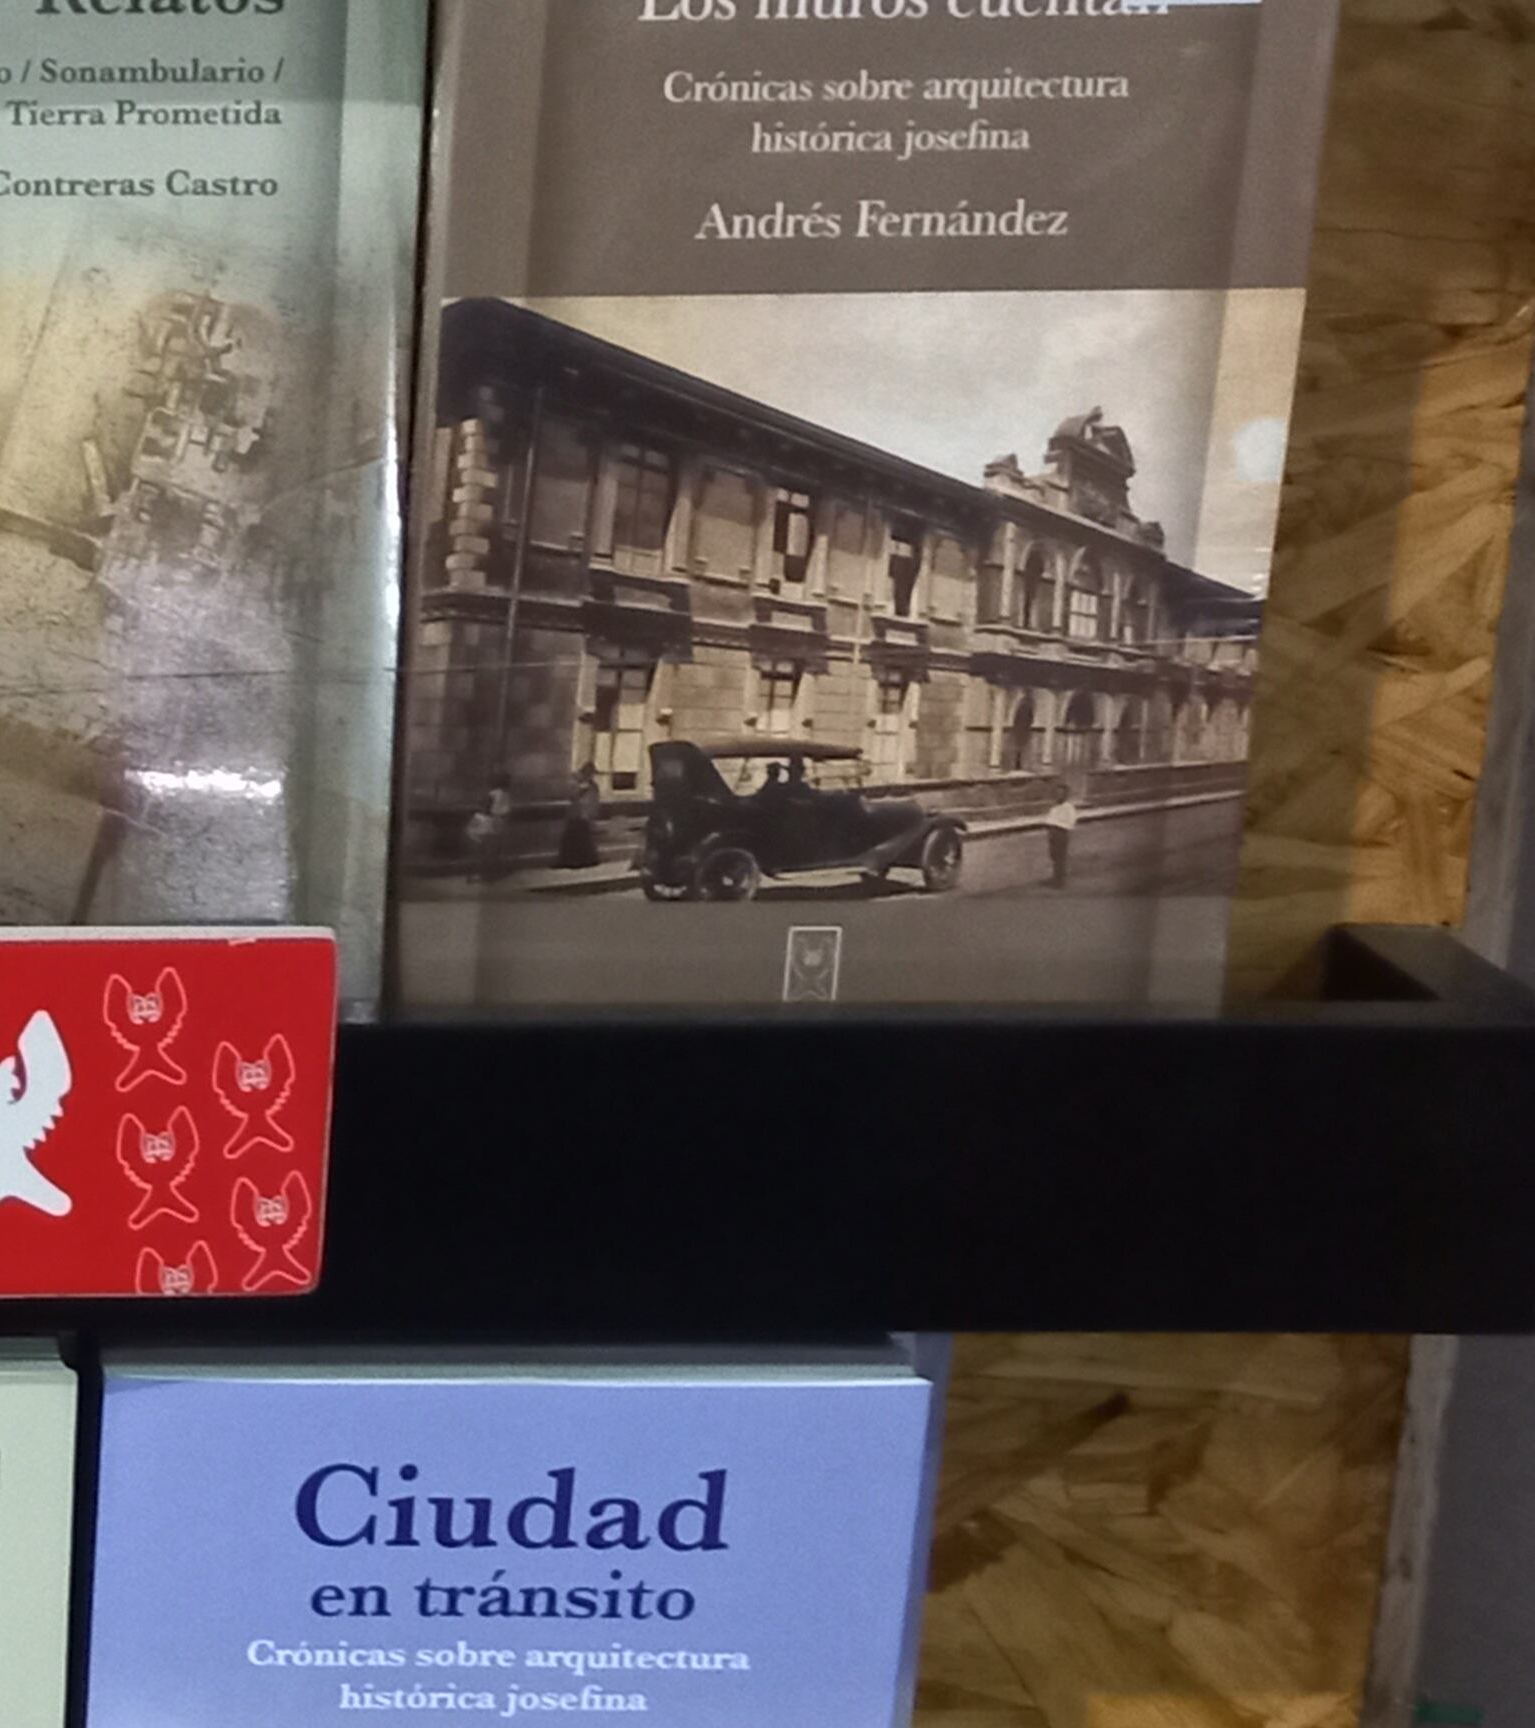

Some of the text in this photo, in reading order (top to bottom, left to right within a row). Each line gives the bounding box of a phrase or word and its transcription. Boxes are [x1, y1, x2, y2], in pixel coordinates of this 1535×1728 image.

[39, 57, 265, 84] Sonambulario
[663, 67, 1129, 110] Crónicas sobre arquitectura
[6, 100, 106, 127] Tierra
[115, 99, 282, 126] Prometida
[751, 119, 1030, 161] histórica josefina
[165, 169, 278, 197] Castro
[694, 198, 1068, 240] Andrés Fernández
[295, 1463, 729, 1552] Ciudad
[310, 1569, 695, 1621] en tránsito
[247, 1639, 751, 1677] Crónicas sobre arquitectura
[339, 1682, 648, 1718] histórica josefina
